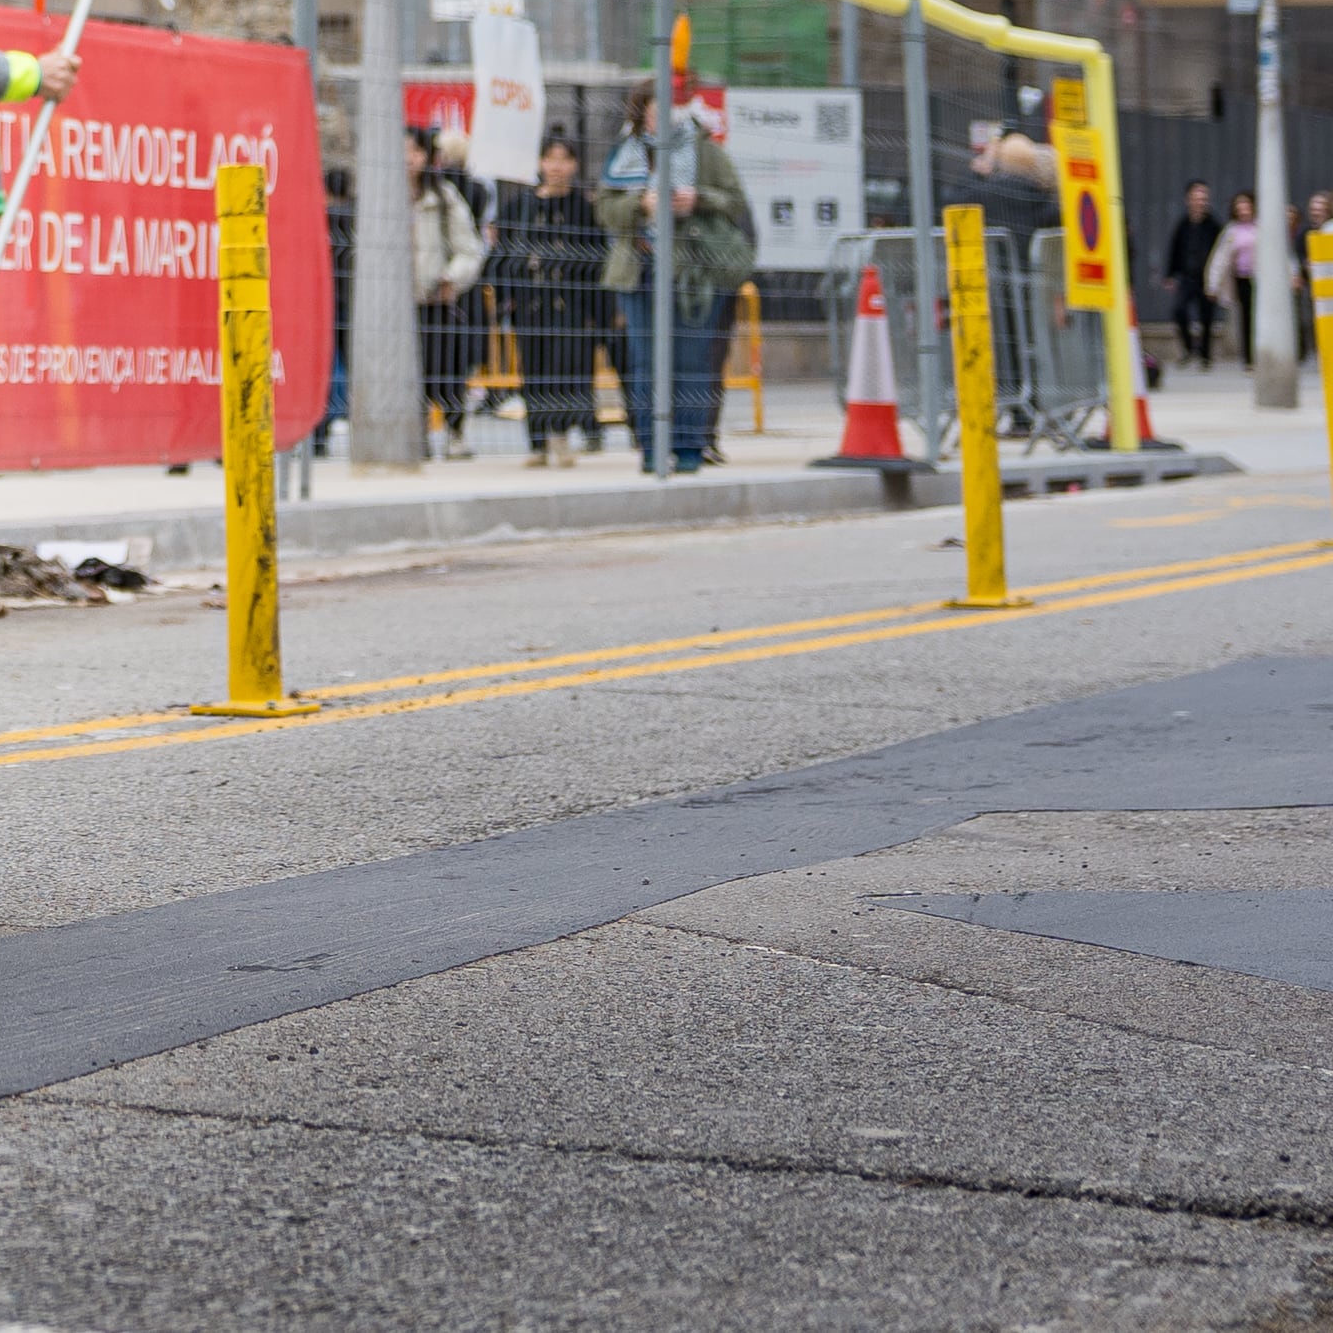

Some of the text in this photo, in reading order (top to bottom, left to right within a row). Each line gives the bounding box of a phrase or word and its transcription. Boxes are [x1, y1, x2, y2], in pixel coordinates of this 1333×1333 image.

[39, 211, 84, 274] DE
[91, 215, 130, 277] LA
[135, 217, 221, 280] MARI
[9, 344, 35, 384] DE
[37, 345, 133, 393] PROVENÇA
[145, 347, 169, 385] DE
